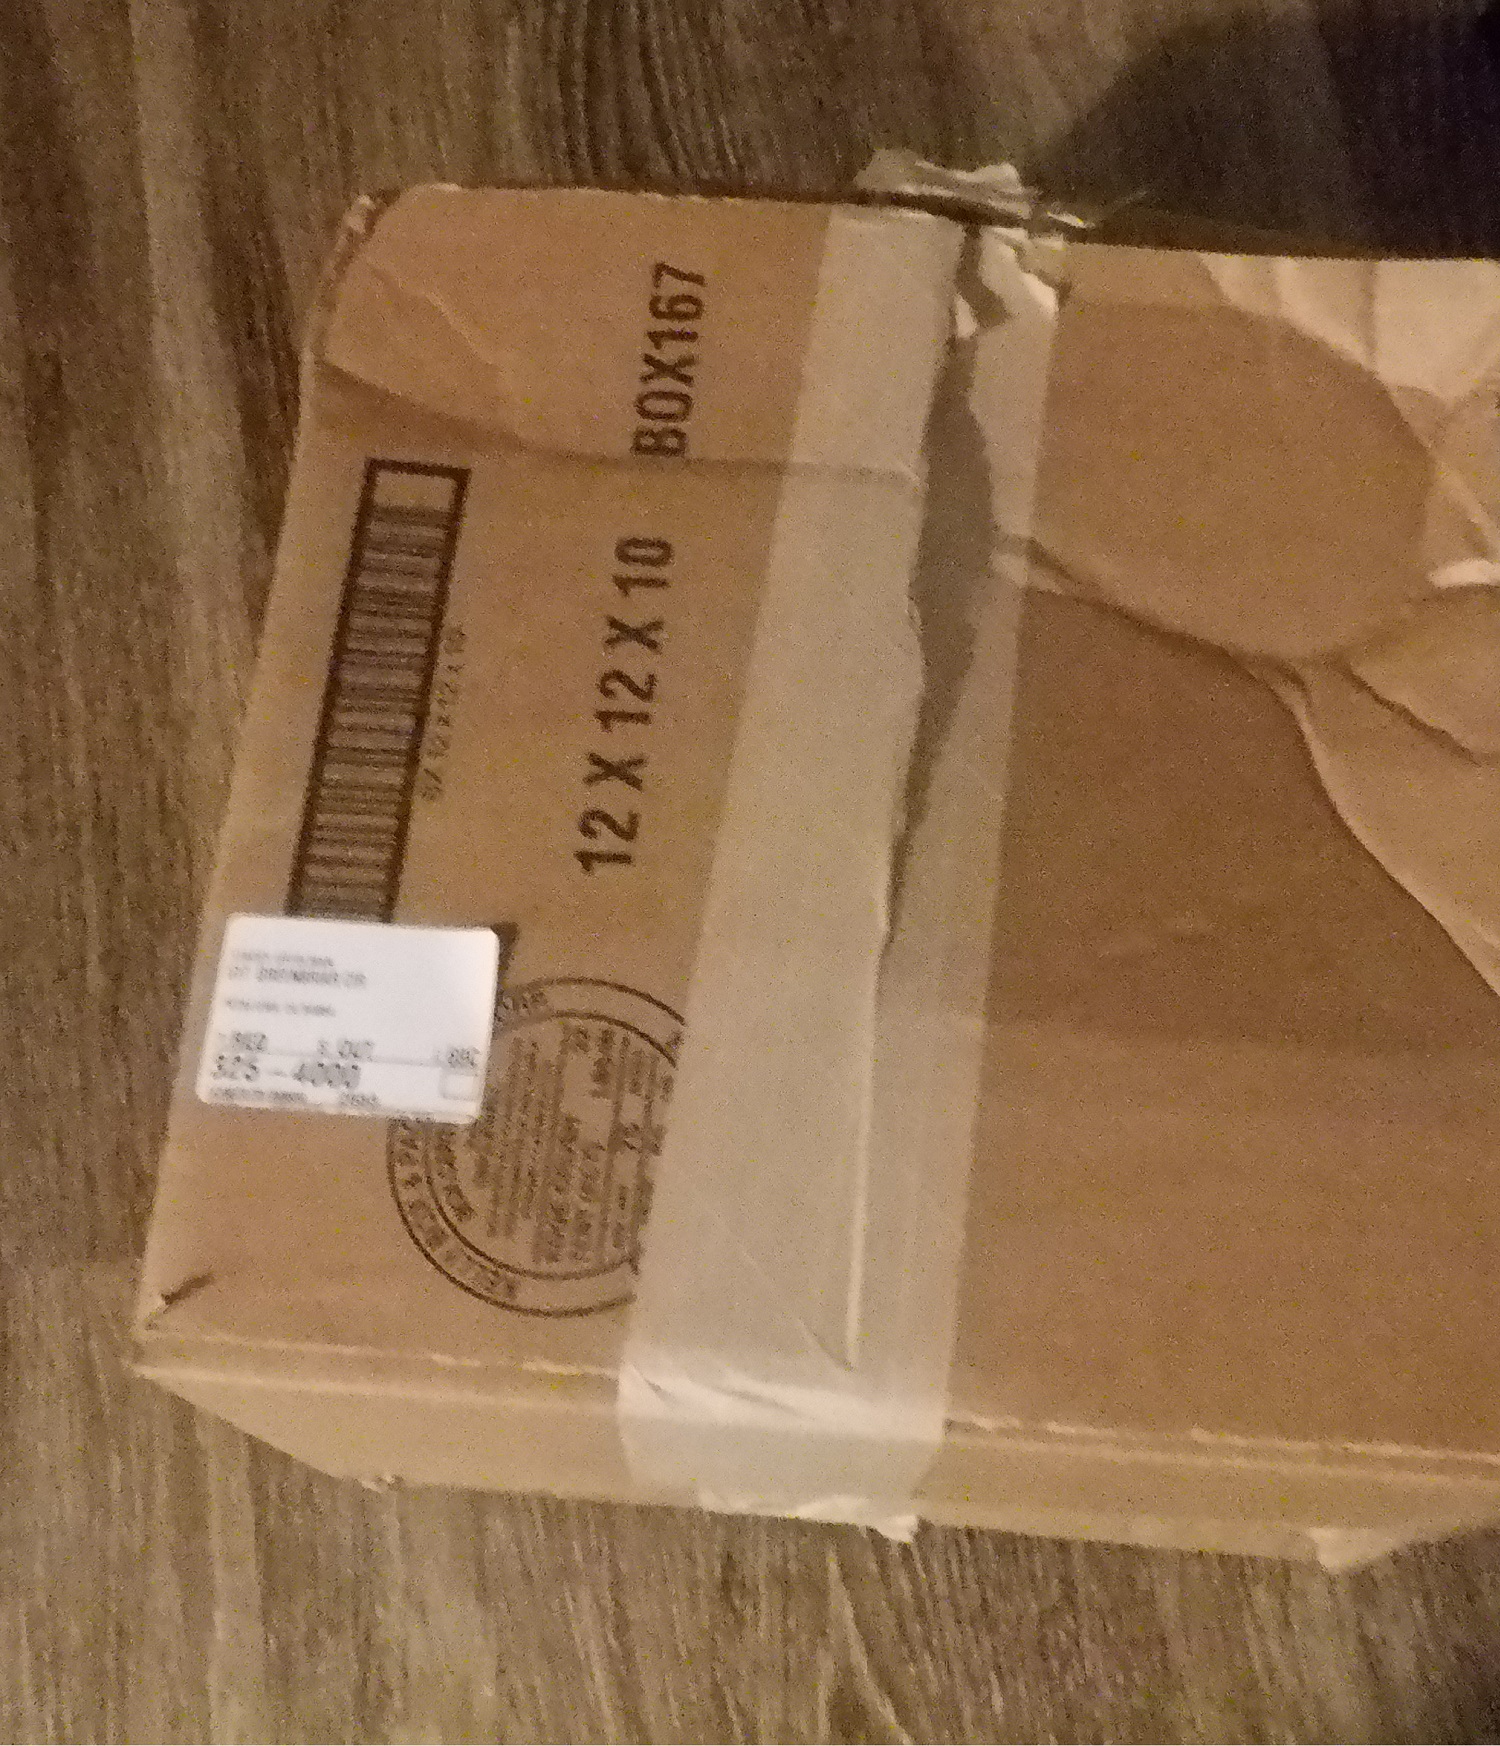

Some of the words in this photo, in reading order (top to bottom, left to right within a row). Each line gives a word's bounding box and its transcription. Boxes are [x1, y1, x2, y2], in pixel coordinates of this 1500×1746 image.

[631, 261, 707, 458] BOX167
[613, 536, 674, 597] 10
[605, 615, 666, 650] X
[595, 669, 659, 732] 12
[583, 752, 649, 792] X
[574, 809, 641, 872] 12
